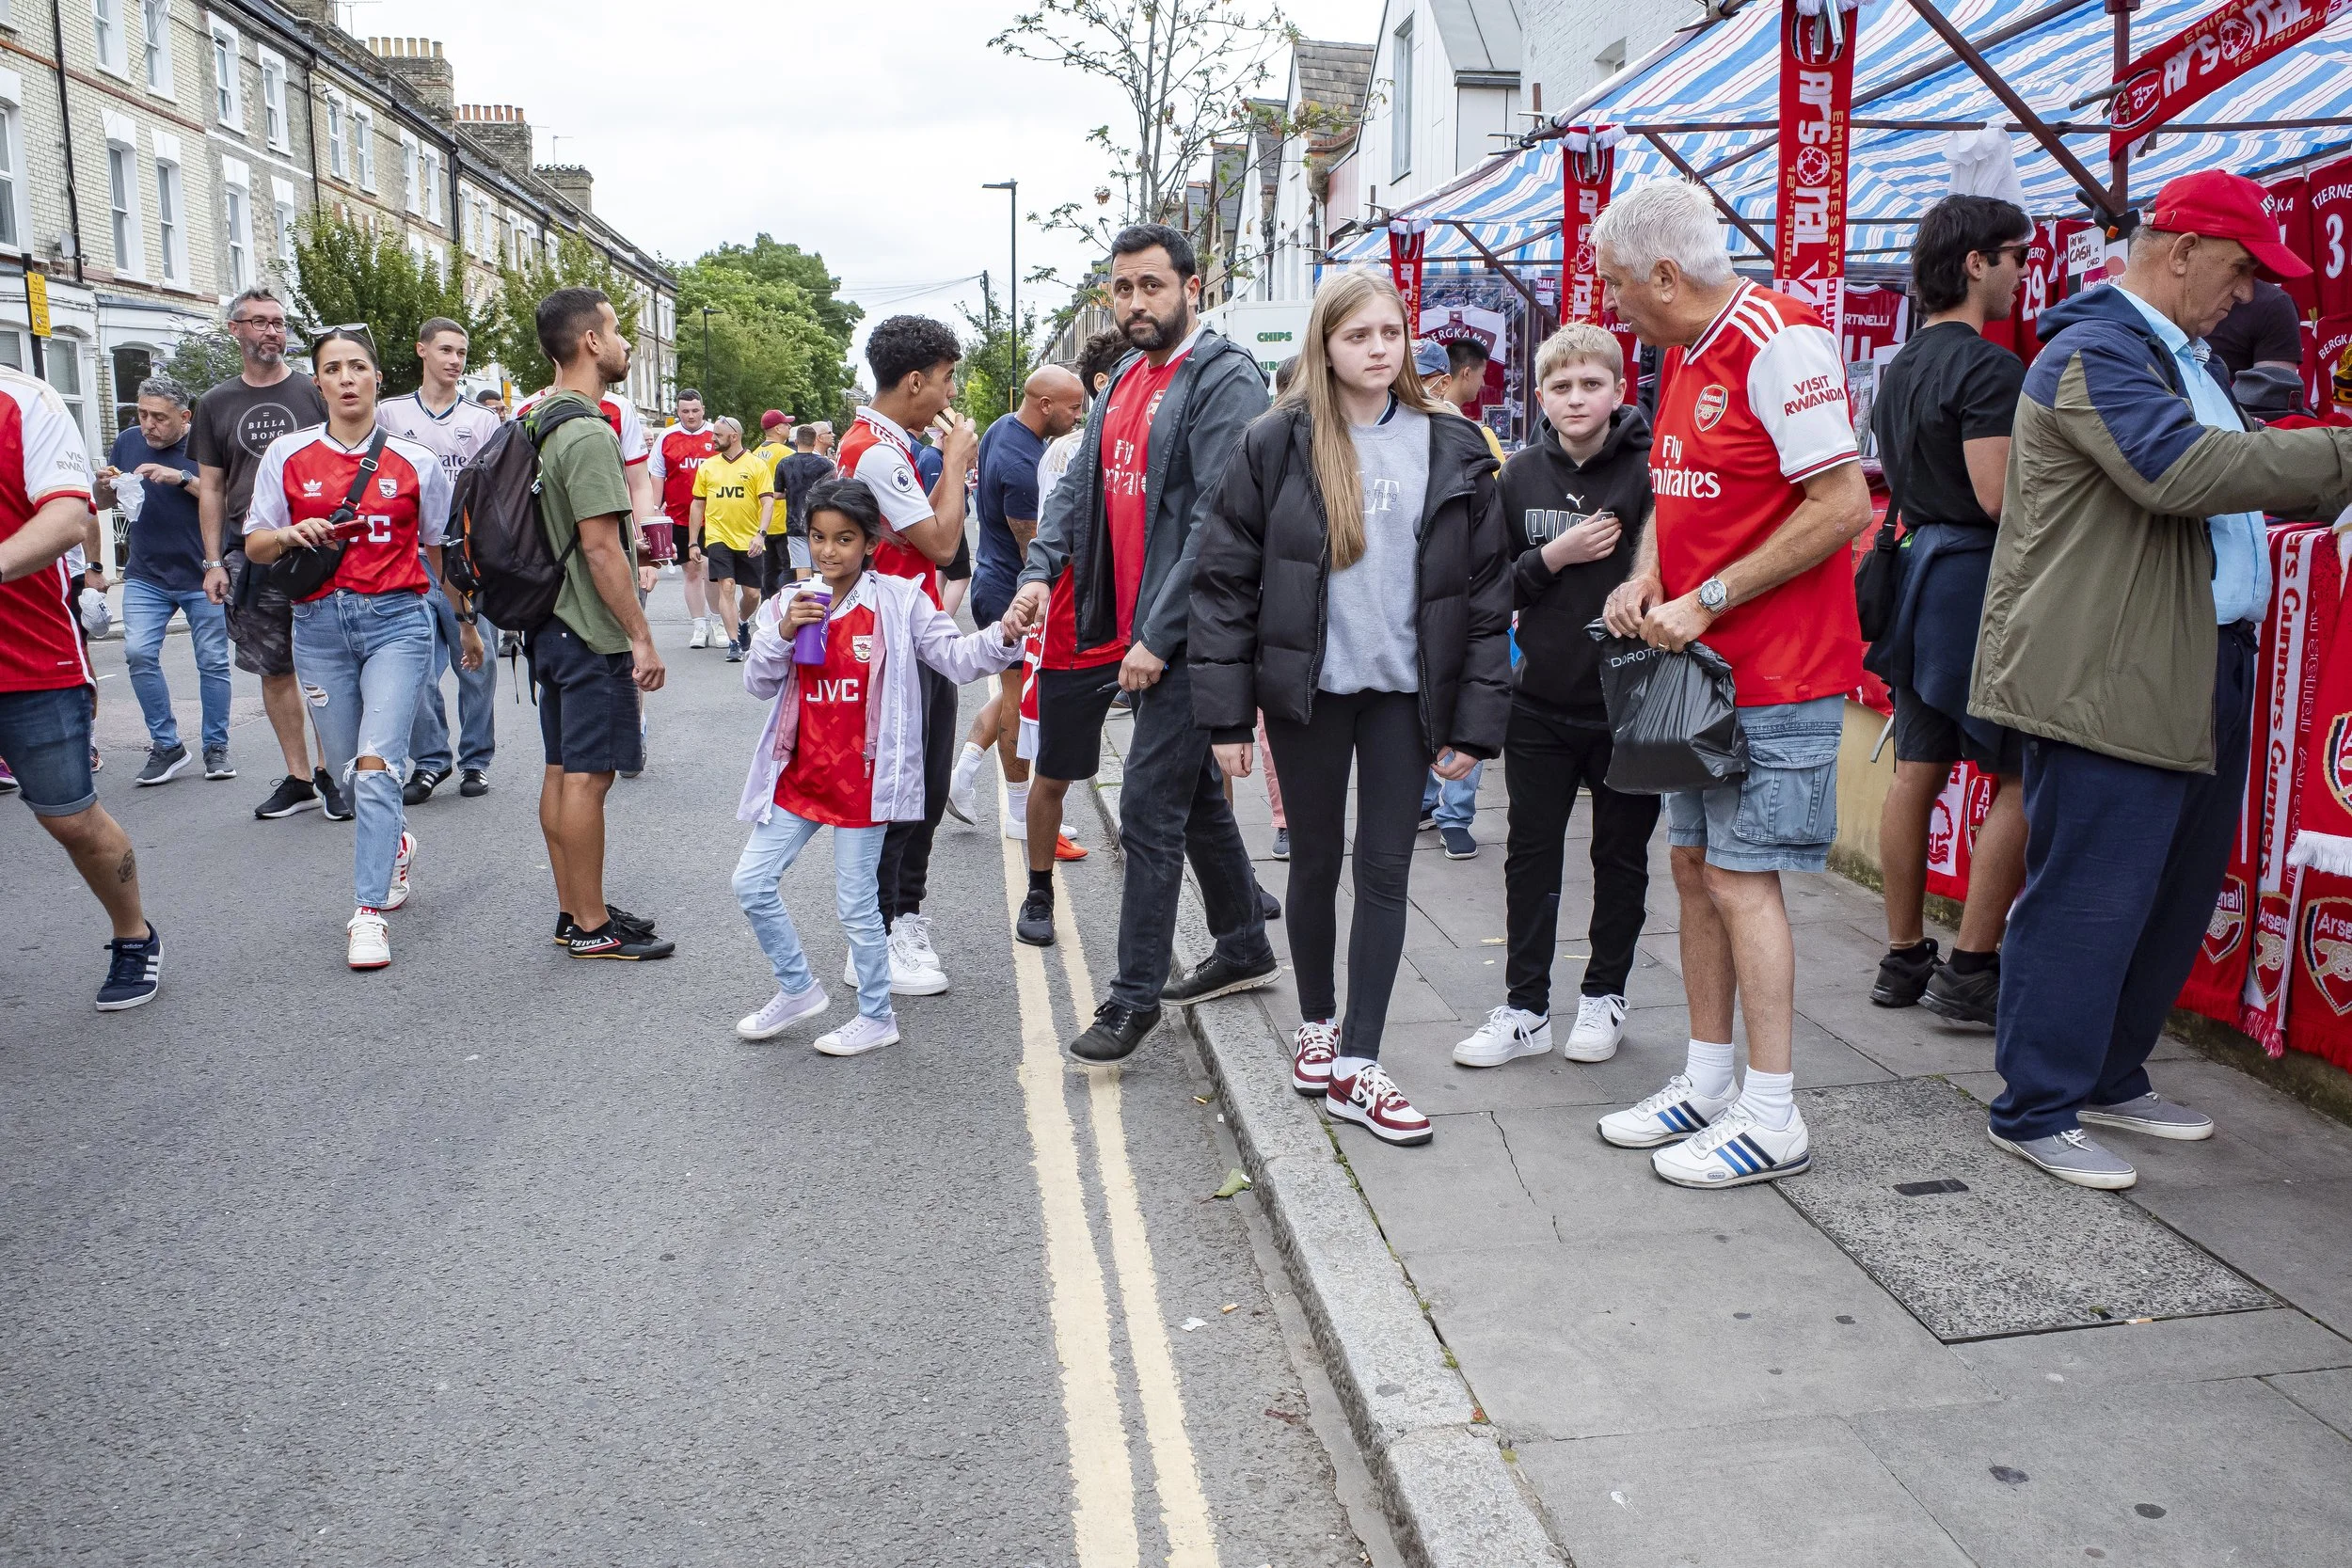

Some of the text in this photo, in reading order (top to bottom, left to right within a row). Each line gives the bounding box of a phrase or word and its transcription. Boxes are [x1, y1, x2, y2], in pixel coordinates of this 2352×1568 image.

[2273, 0, 2343, 46] AUGUS
[1829, 110, 1844, 228] EMIRATES
[2277, 198, 2294, 213] KA
[2312, 183, 2352, 210] TIERNE
[1782, 214, 1794, 294] AUGUS
[2027, 247, 2046, 261] ERTZ
[2070, 245, 2090, 263] CASH
[2326, 214, 2345, 279] 3
[1537, 278, 1555, 290] SALE
[2021, 264, 2046, 321] 29
[1411, 285, 1420, 339] EMIRATE
[1843, 312, 1890, 326] RTINELLI
[1257, 332, 1293, 342] CHIPS
[1602, 323, 1630, 333] AARD
[1792, 374, 1830, 396] VISIT
[1703, 392, 1723, 404] Arsenal
[1784, 387, 1845, 417] RWANDA
[247, 419, 285, 429] BILLA
[251, 430, 284, 440] BONG
[66, 451, 84, 463] VIS
[1661, 435, 1683, 465] Fly
[716, 486, 744, 498] JVC
[1525, 509, 1615, 546] PU
[846, 590, 860, 610] AFC
[2273, 588, 2301, 732] Gunners
[806, 678, 859, 702] JVC
[2260, 739, 2287, 880] Gunners
[2317, 911, 2352, 940] Arse
[570, 938, 602, 947] FEIYUE
